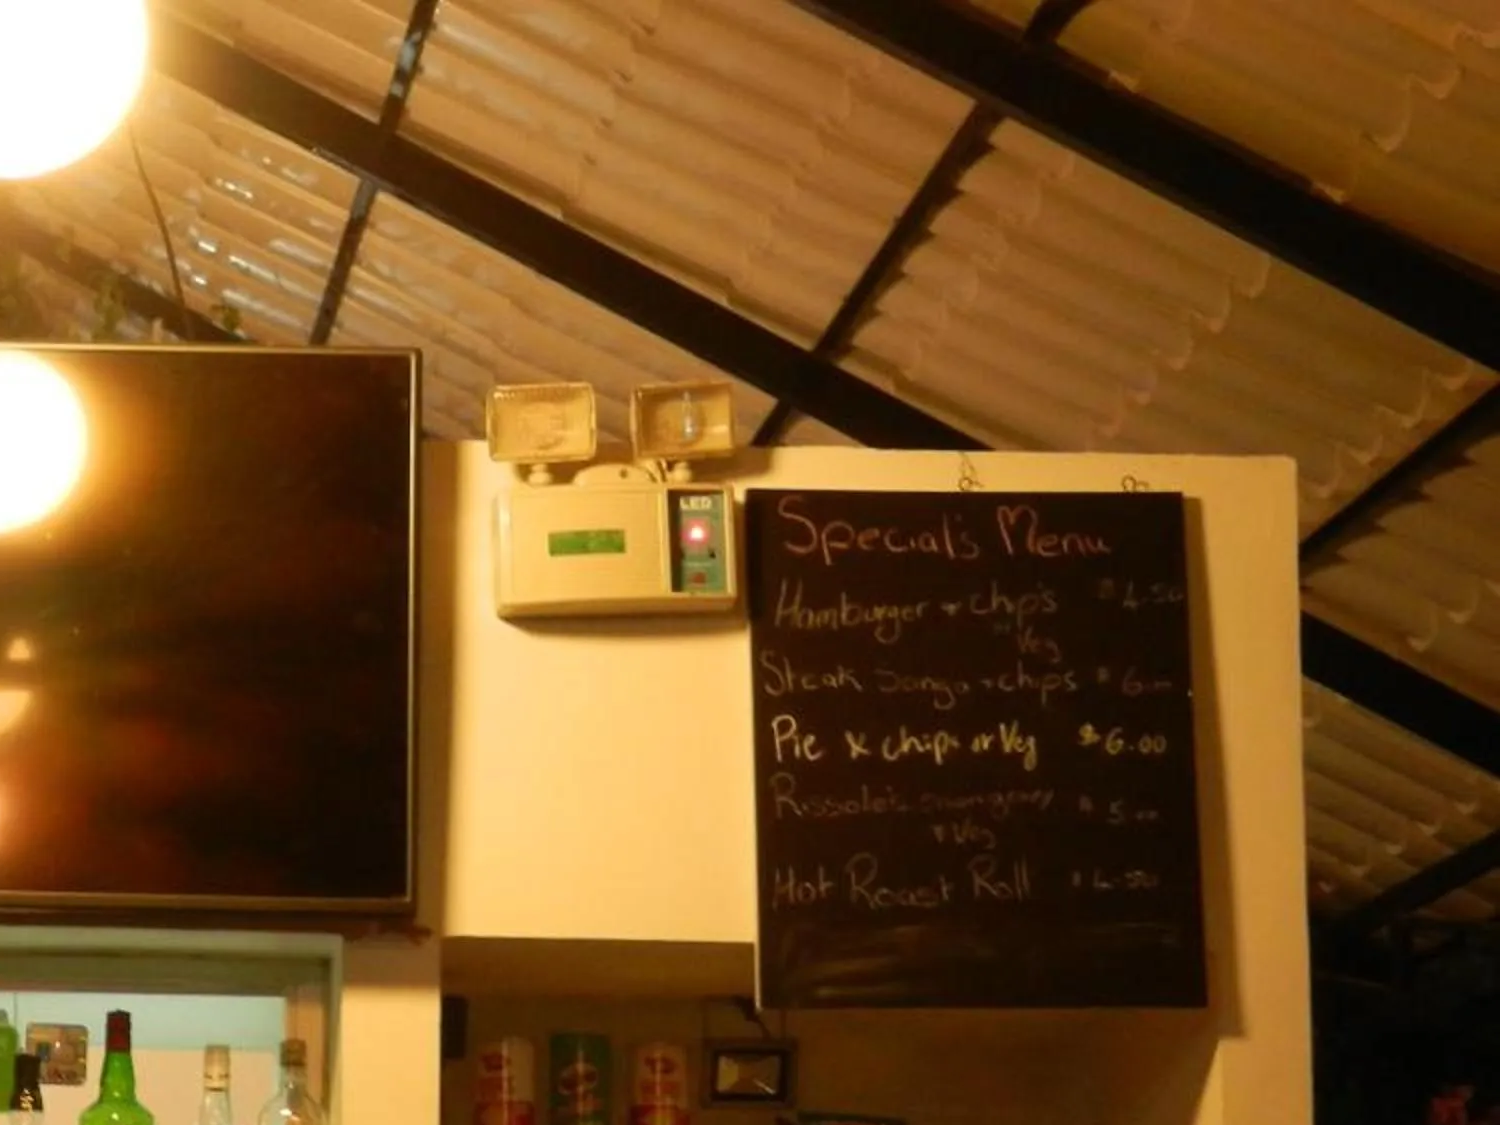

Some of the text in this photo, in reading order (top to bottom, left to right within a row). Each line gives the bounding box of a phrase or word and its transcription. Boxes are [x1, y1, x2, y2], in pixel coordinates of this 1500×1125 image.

[678, 495, 713, 511] LED
[995, 503, 1114, 559] Menu
[773, 576, 930, 645] Hamburger
[758, 648, 864, 699] Steak
[770, 713, 824, 763] Pie
[998, 718, 1039, 772] Veg
[1076, 721, 1169, 757] $6.00
[771, 864, 835, 911] Hot
[966, 852, 1032, 902] Roll
